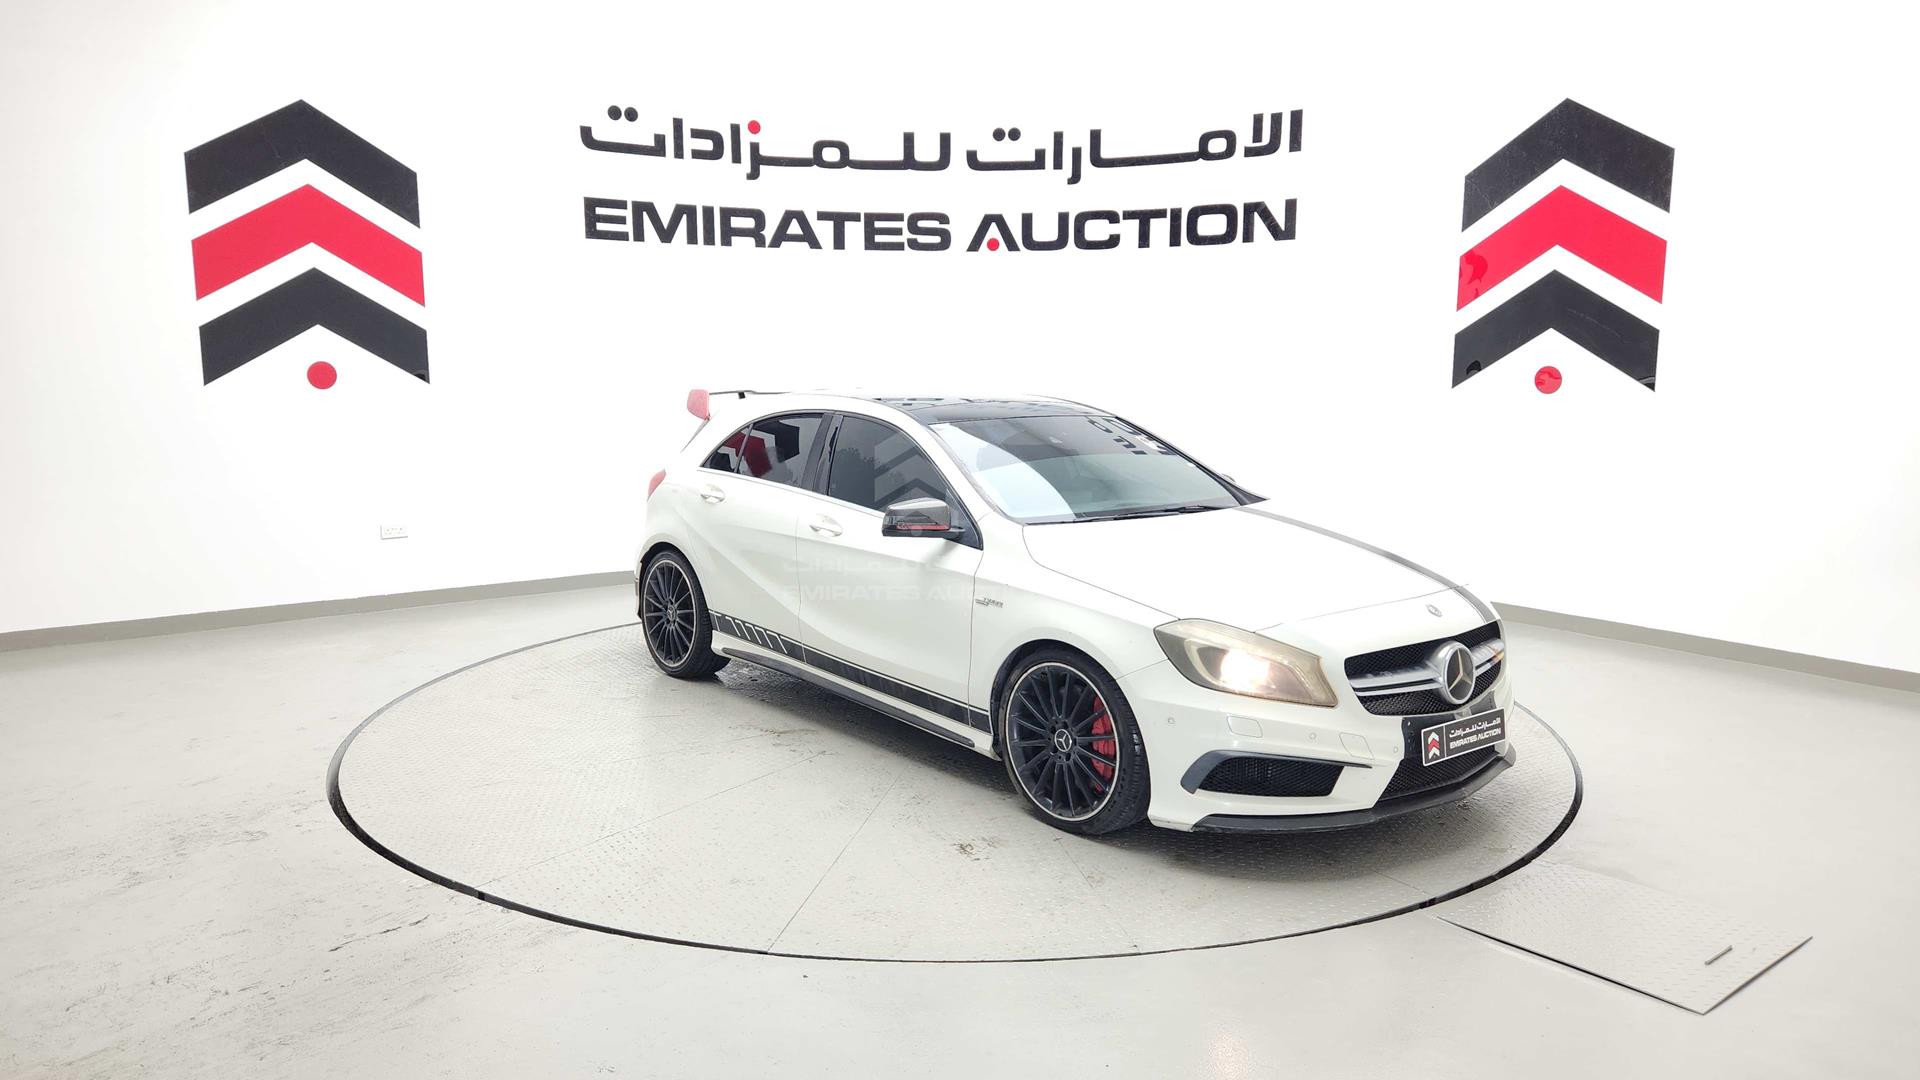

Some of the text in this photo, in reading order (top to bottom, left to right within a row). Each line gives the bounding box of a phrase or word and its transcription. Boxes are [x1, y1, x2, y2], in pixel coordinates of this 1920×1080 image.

[580, 105, 951, 181] للمزادات
[583, 196, 1297, 252] EMIRATES AUCTION
[1449, 728, 1502, 749] EMIRATES AUCTION
